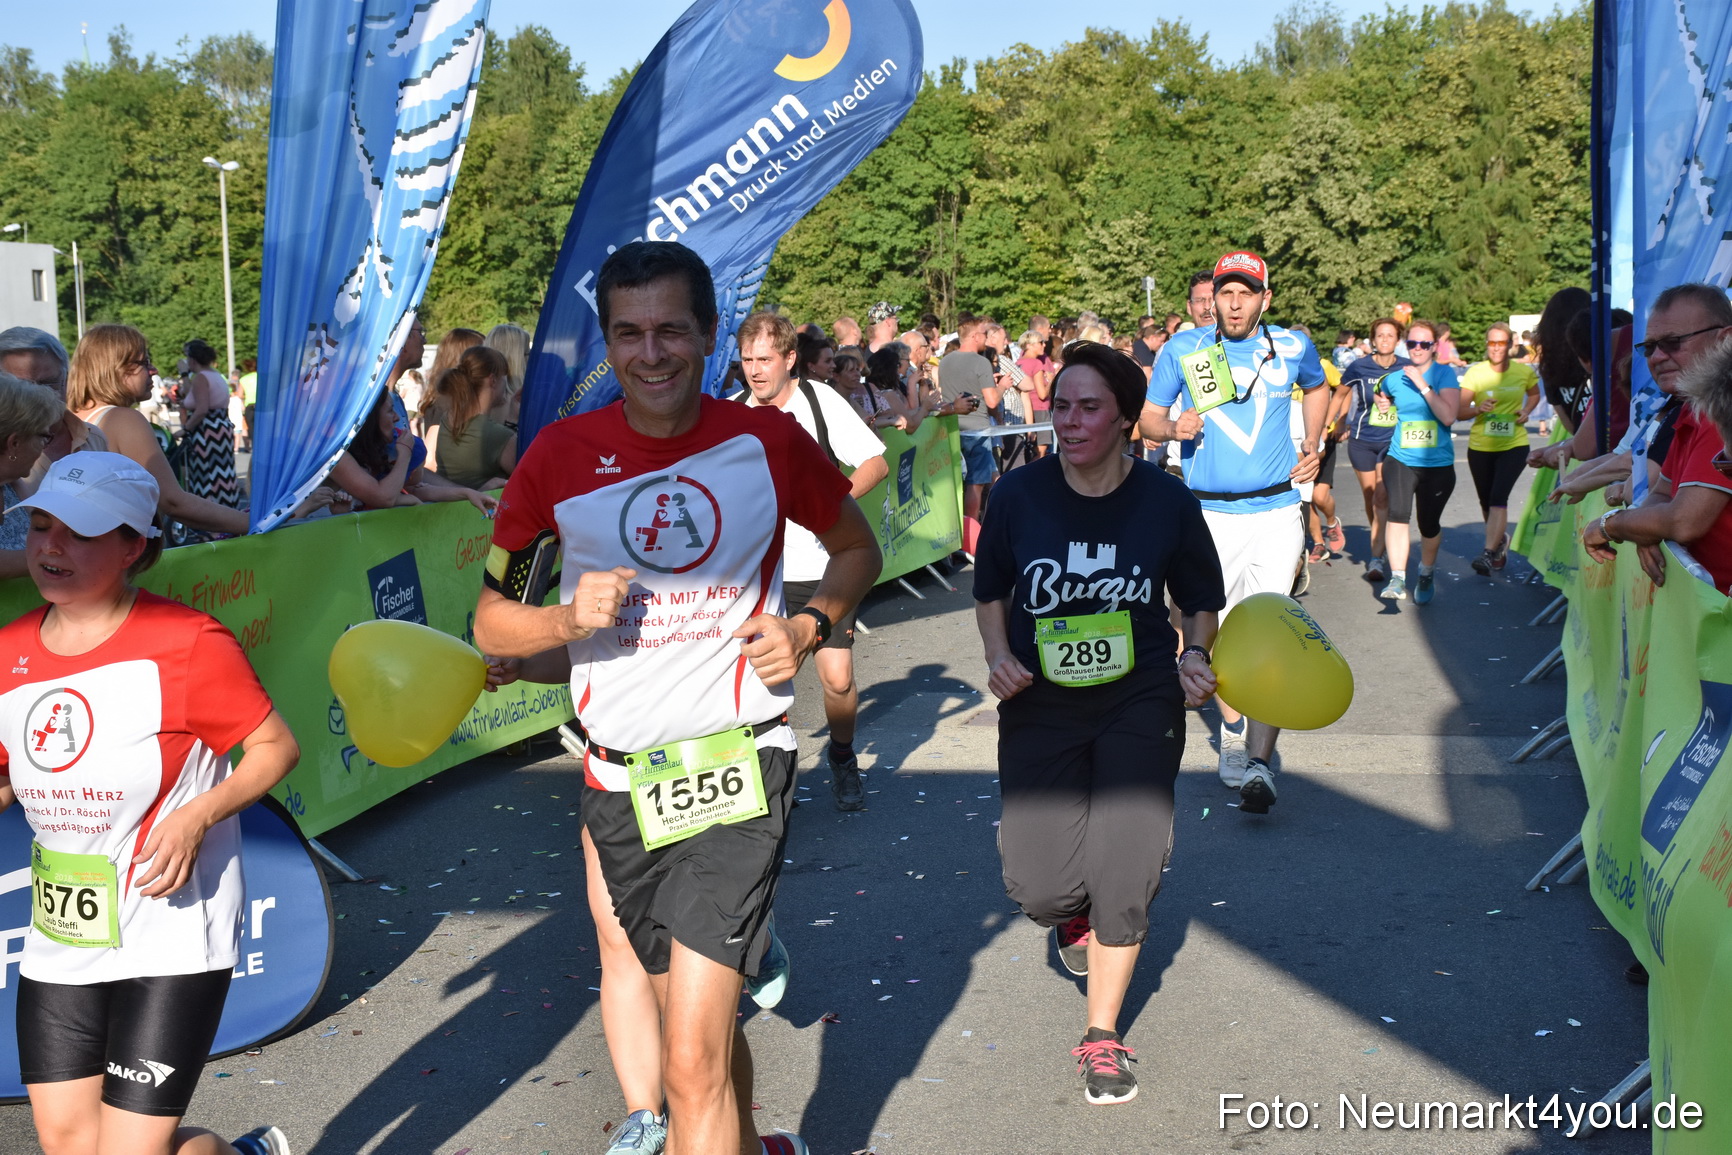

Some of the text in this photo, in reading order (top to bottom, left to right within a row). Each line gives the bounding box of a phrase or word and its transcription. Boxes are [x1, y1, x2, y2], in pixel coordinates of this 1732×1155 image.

[728, 58, 897, 213] Druck und Medien
[1195, 360, 1217, 394] 379
[1377, 413, 1395, 421] 516
[1490, 421, 1509, 431] 964
[1405, 431, 1432, 440] 1524
[595, 466, 621, 474] erima
[192, 569, 256, 612] Firmen
[1023, 558, 1152, 615] Burgis
[382, 585, 415, 614] Fischer
[670, 591, 699, 605] MIT
[615, 617, 632, 627] Dr.
[634, 616, 664, 627] Heck
[1285, 607, 1331, 651] Burgis
[1058, 639, 1112, 668] 289
[1054, 663, 1122, 676] Großhauser Monika
[1688, 734, 1721, 768] Fischer
[52, 789, 75, 800] MIT
[82, 787, 124, 801] HERZ
[647, 766, 744, 816] 1556
[60, 808, 75, 816] Dr.
[76, 807, 111, 818] Röschl
[661, 813, 686, 826] Heck
[688, 799, 736, 819] Johannes
[669, 822, 689, 832] Praxis
[35, 876, 99, 921] 1576
[44, 913, 78, 930] Laub Steffi
[107, 1062, 151, 1083] JAKO
